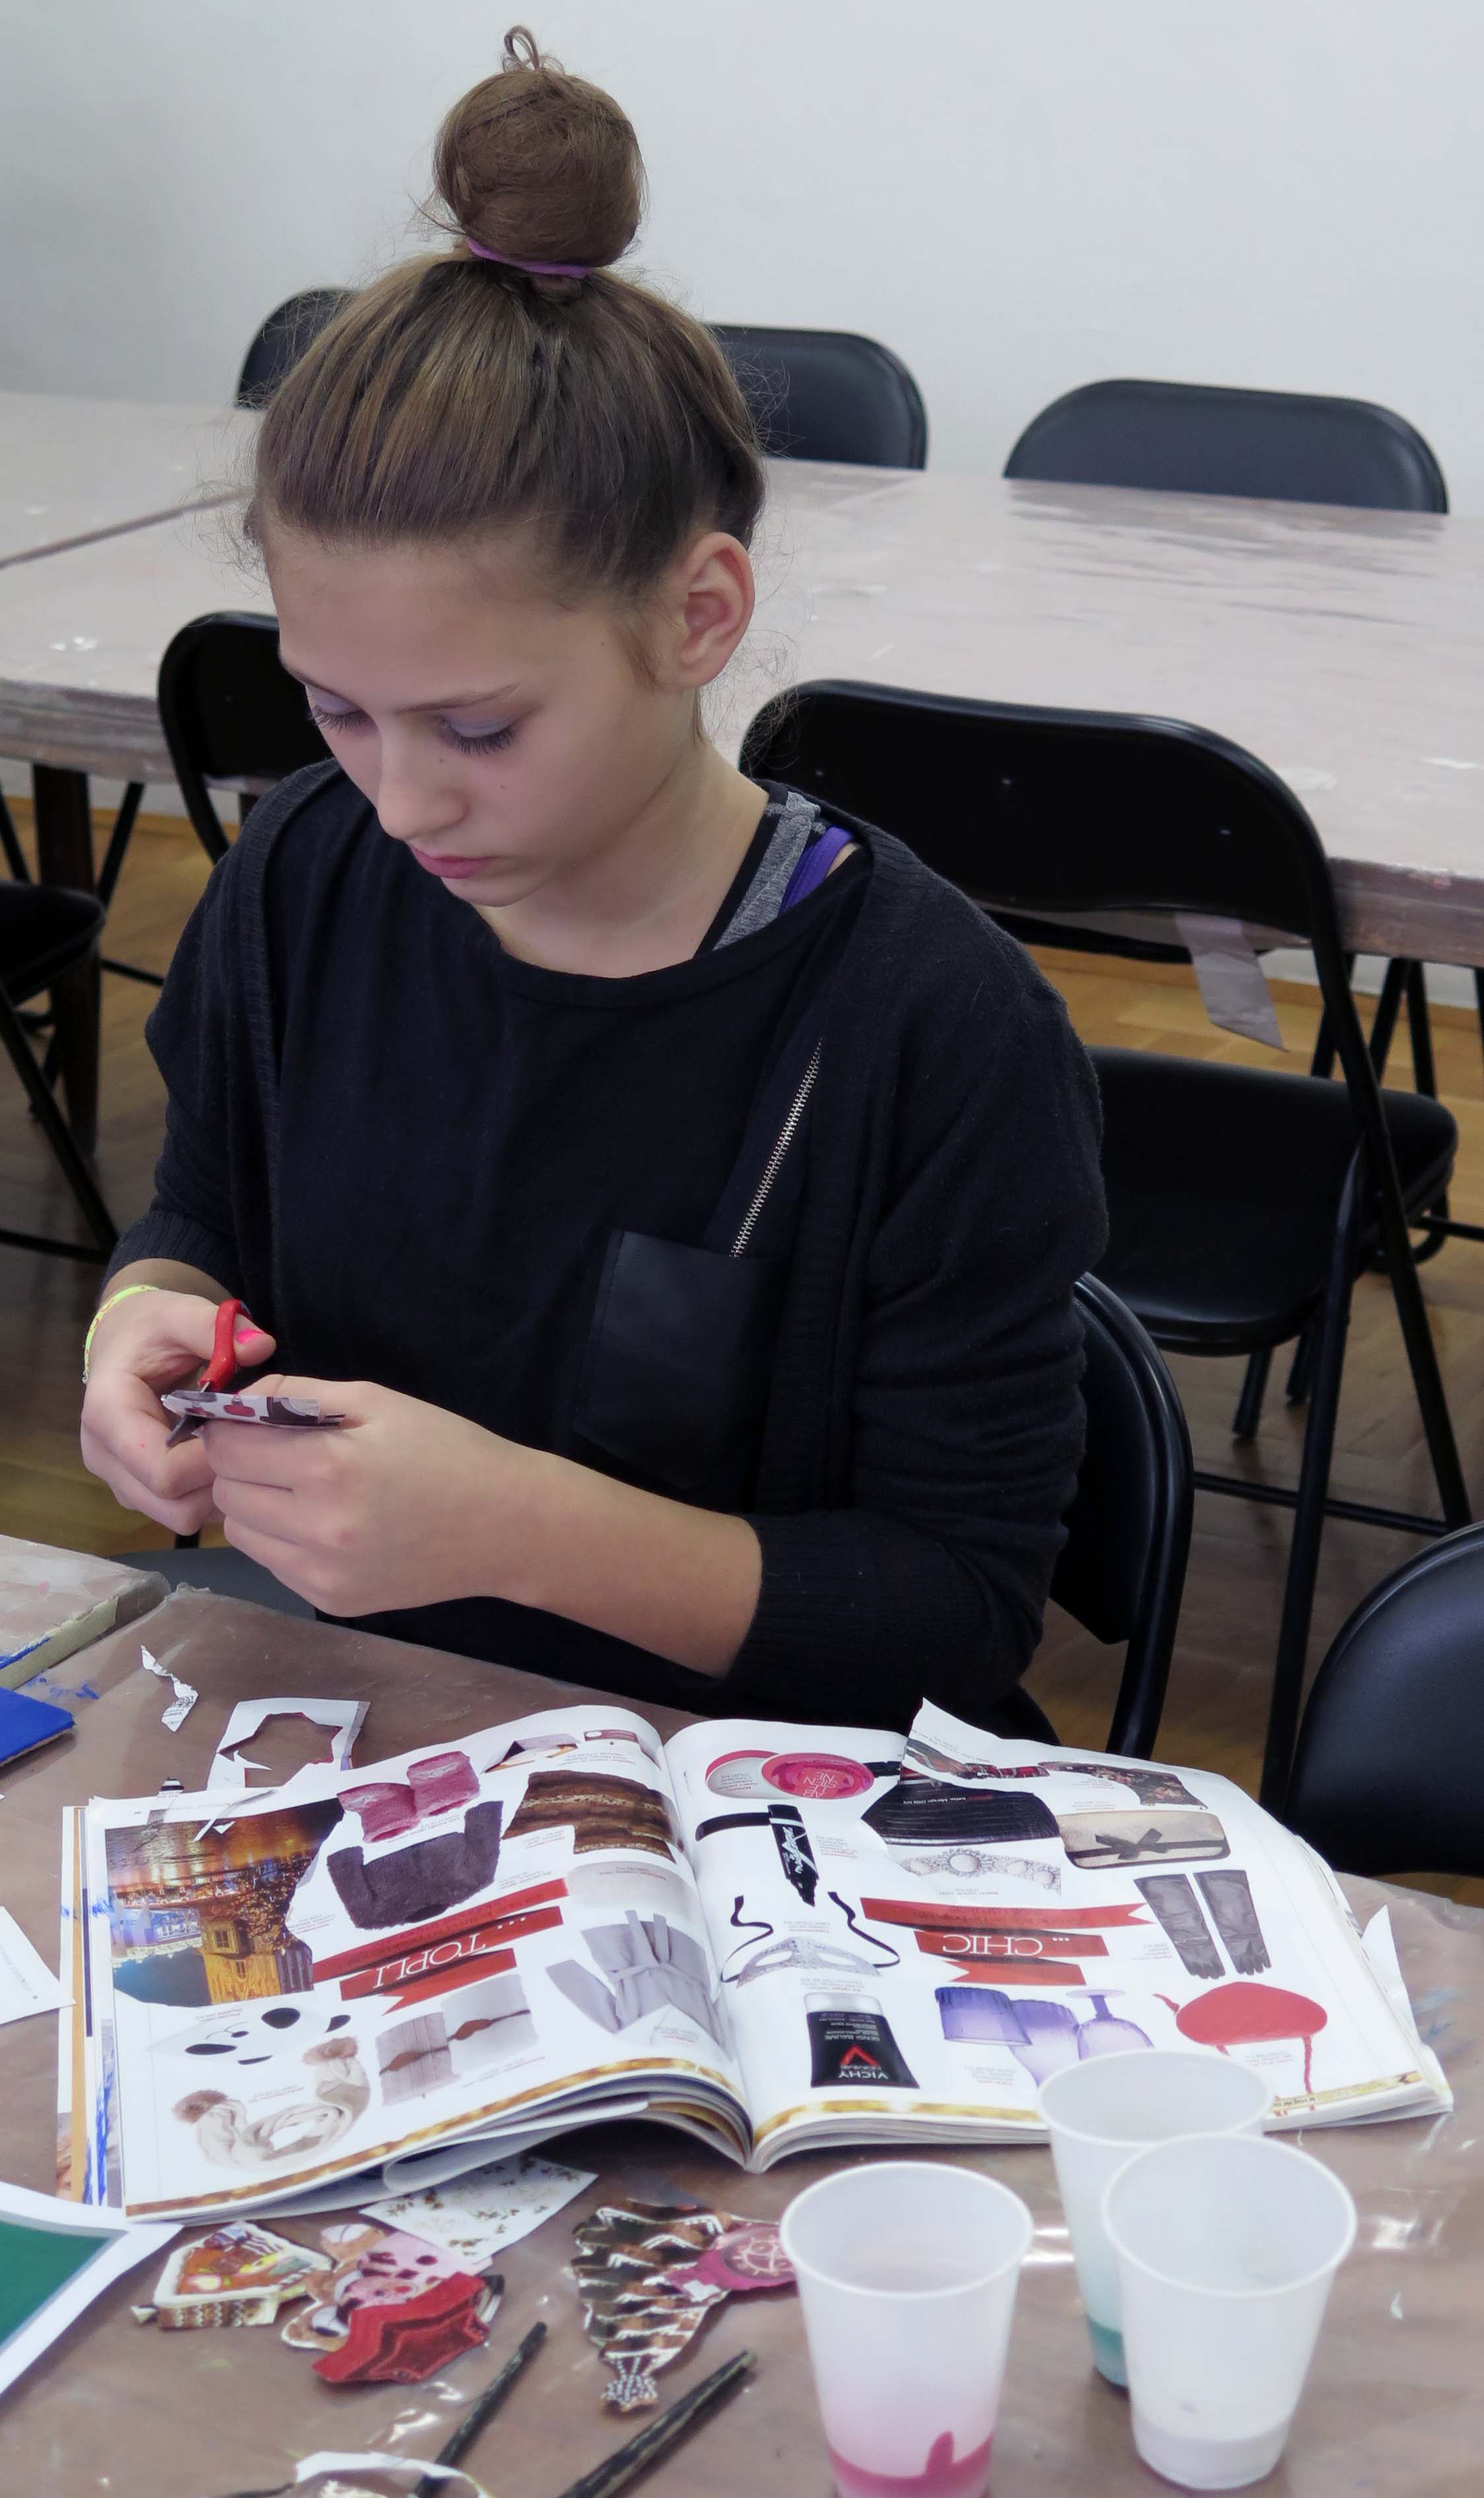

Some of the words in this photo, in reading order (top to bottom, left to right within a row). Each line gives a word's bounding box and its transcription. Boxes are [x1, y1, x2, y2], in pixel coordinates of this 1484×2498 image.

[942, 1934, 1043, 1957] CHIC
[373, 1933, 487, 1988] TOPLI
[838, 2071, 889, 2080] VICHY
